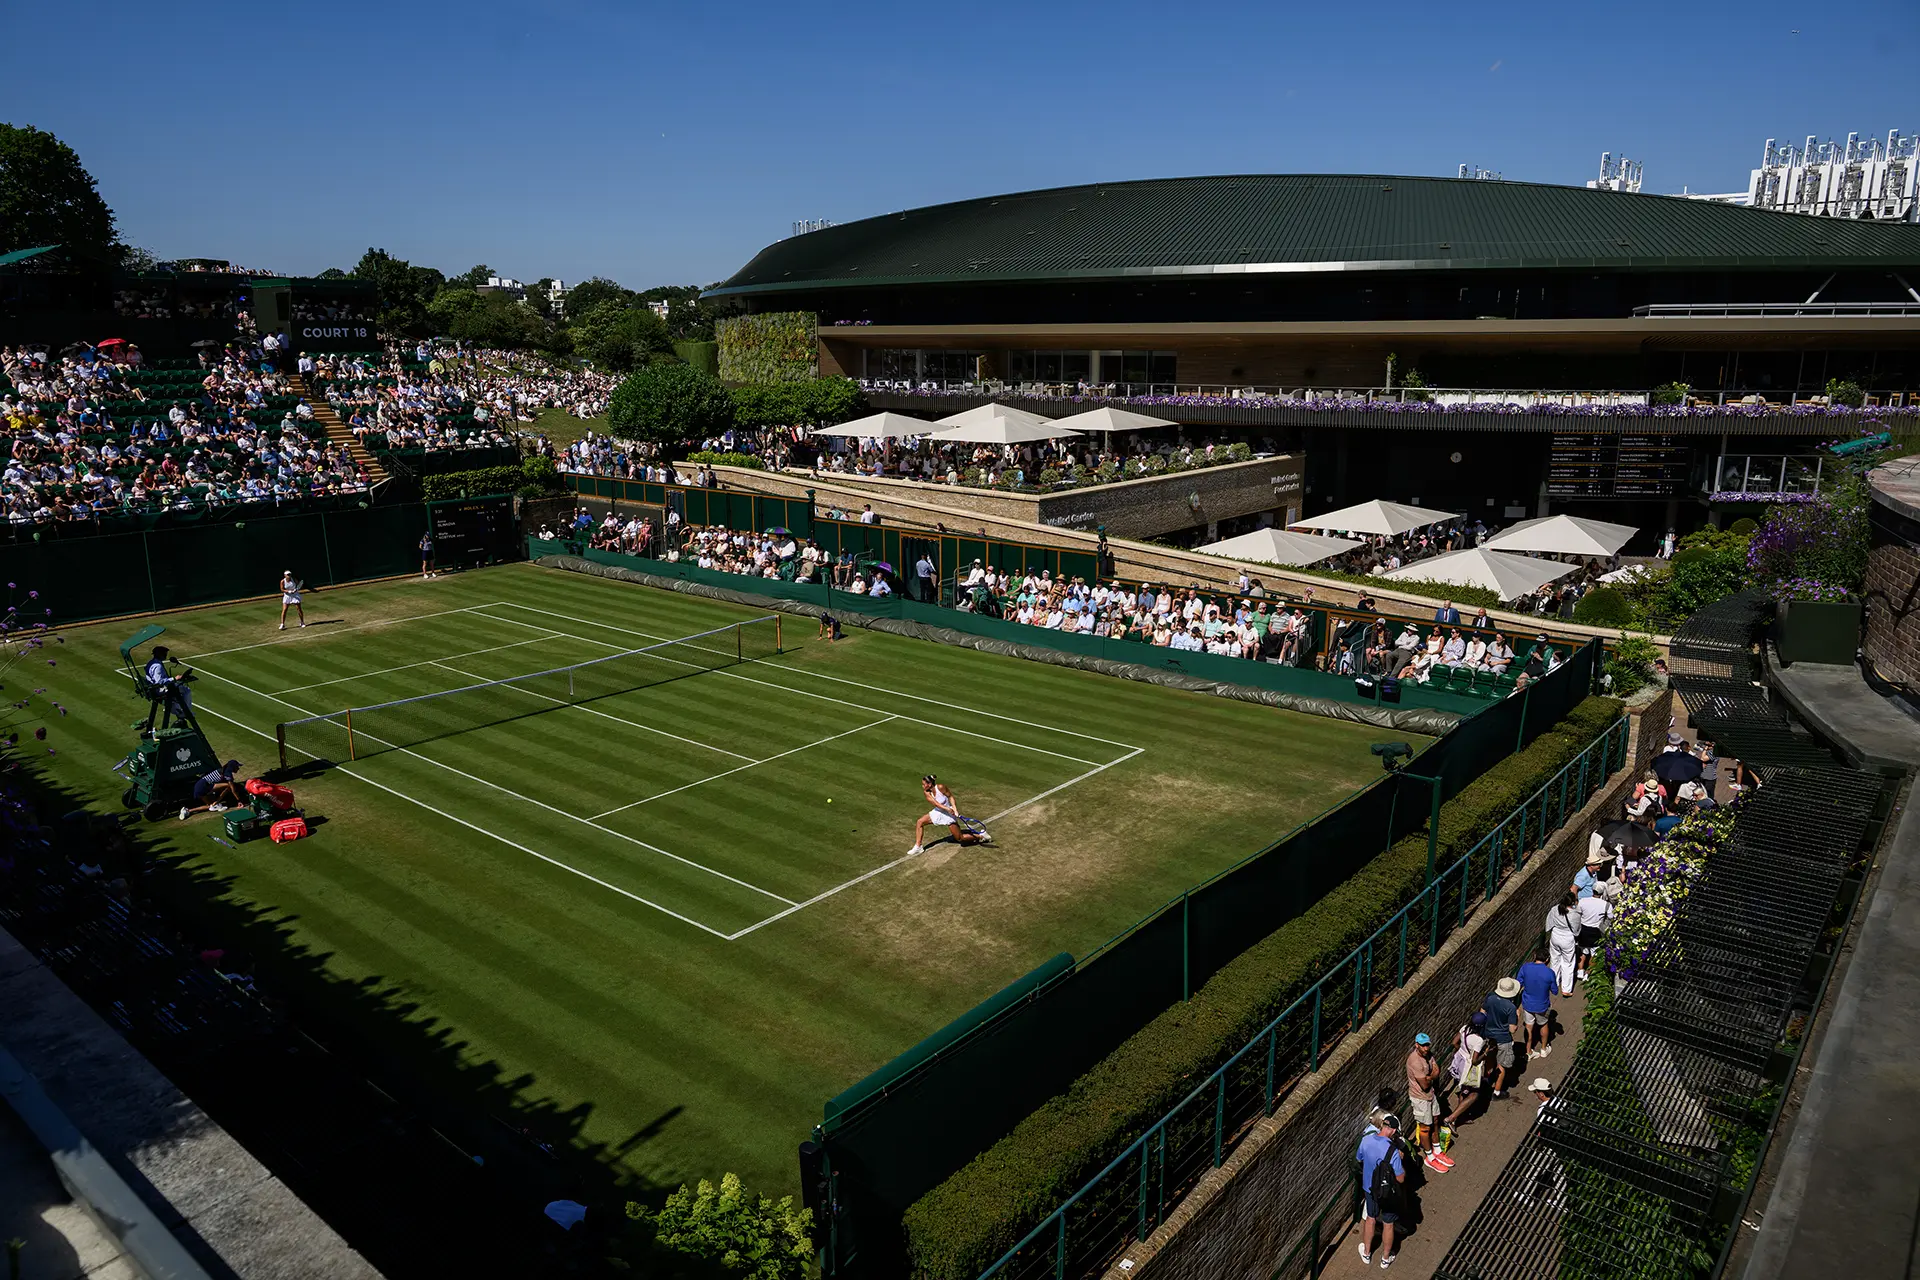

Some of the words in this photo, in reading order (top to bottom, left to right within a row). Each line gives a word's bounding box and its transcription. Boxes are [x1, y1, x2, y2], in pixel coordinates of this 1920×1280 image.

[303, 327, 349, 338] COURT
[354, 327, 367, 338] 18
[1046, 515, 1070, 526] Walled
[1071, 512, 1095, 523] Garden
[170, 760, 201, 772] BARCLAYS
[264, 792, 284, 806] Wilson
